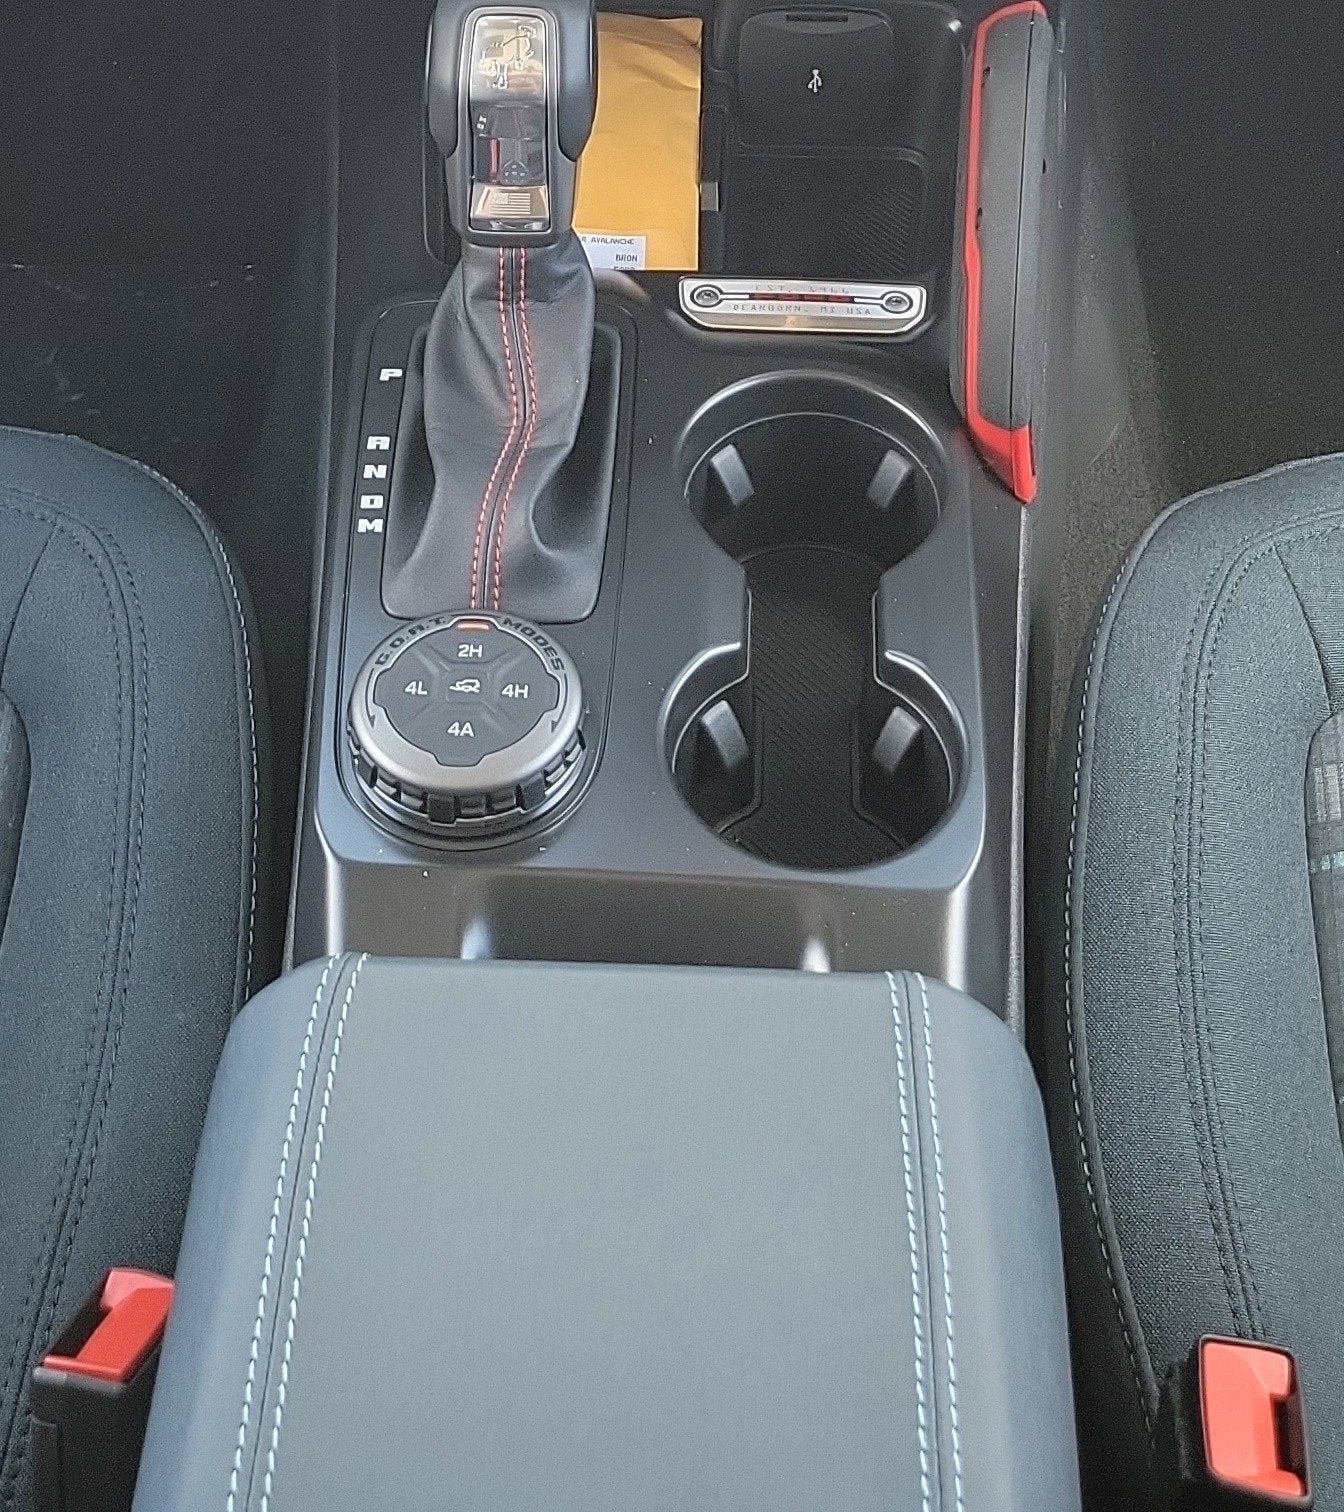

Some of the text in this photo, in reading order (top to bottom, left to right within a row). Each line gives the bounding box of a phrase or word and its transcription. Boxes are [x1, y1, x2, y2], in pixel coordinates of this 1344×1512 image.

[846, 307, 872, 316] USA
[380, 368, 403, 382] P
[363, 464, 387, 479] N
[360, 494, 384, 509] D
[358, 519, 384, 534] M
[458, 644, 483, 658] 2H
[503, 617, 565, 671] MODES
[404, 681, 428, 695] 4L
[502, 683, 529, 698] 4H
[447, 721, 474, 738] 4A
